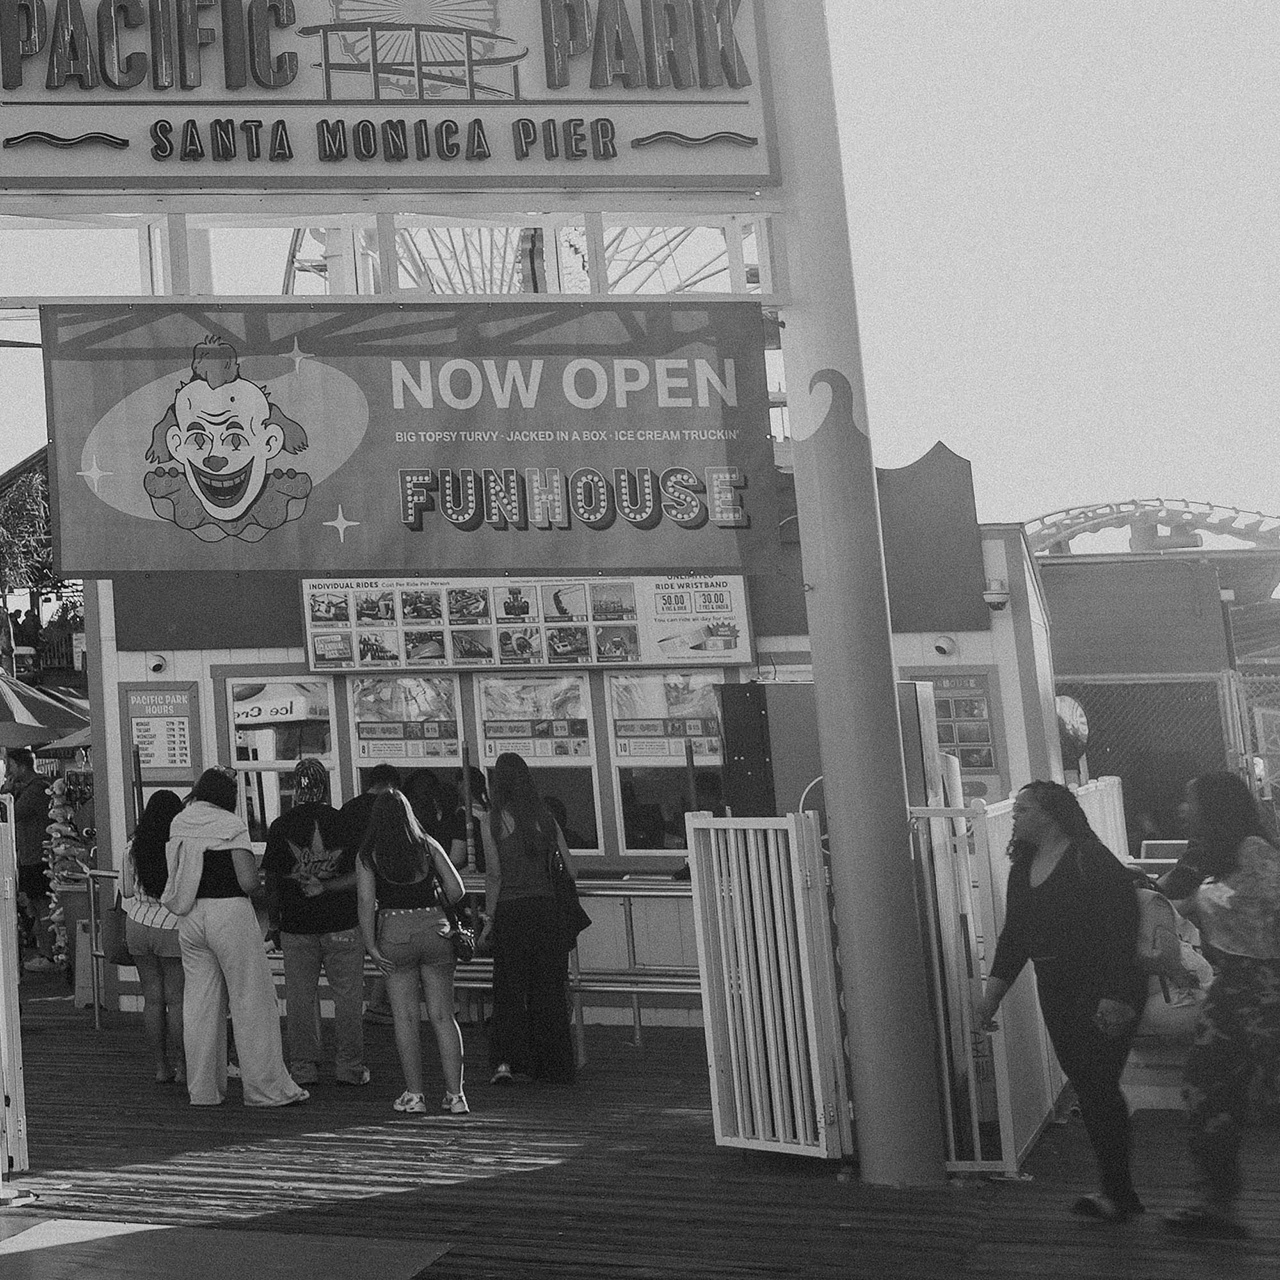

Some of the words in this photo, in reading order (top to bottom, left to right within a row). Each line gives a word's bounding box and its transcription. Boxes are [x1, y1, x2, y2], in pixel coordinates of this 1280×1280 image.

[150, 118, 294, 163] SANTA
[316, 117, 492, 163] MONICA
[512, 117, 619, 161] PIER
[390, 358, 545, 410] NOW
[562, 357, 739, 409] OPEN
[395, 430, 416, 443] BIG
[418, 430, 458, 442] TOPSY
[459, 430, 500, 442] TURVY
[506, 430, 555, 442] JACKED
[556, 430, 570, 441] IN
[571, 430, 582, 441] A
[583, 430, 608, 441] BOX
[614, 429, 635, 441] ICE
[636, 429, 682, 441] CREAM
[682, 429, 740, 440] TRUCKIN'
[398, 466, 751, 532] FUNHOUSE
[676, 581, 728, 589] WRISTBAND
[130, 695, 164, 705] PACIFIC
[165, 694, 188, 705] PARK
[145, 705, 175, 715] HOURS
[361, 744, 366, 755] 8
[487, 743, 493, 754] 9
[619, 743, 627, 753] 10
